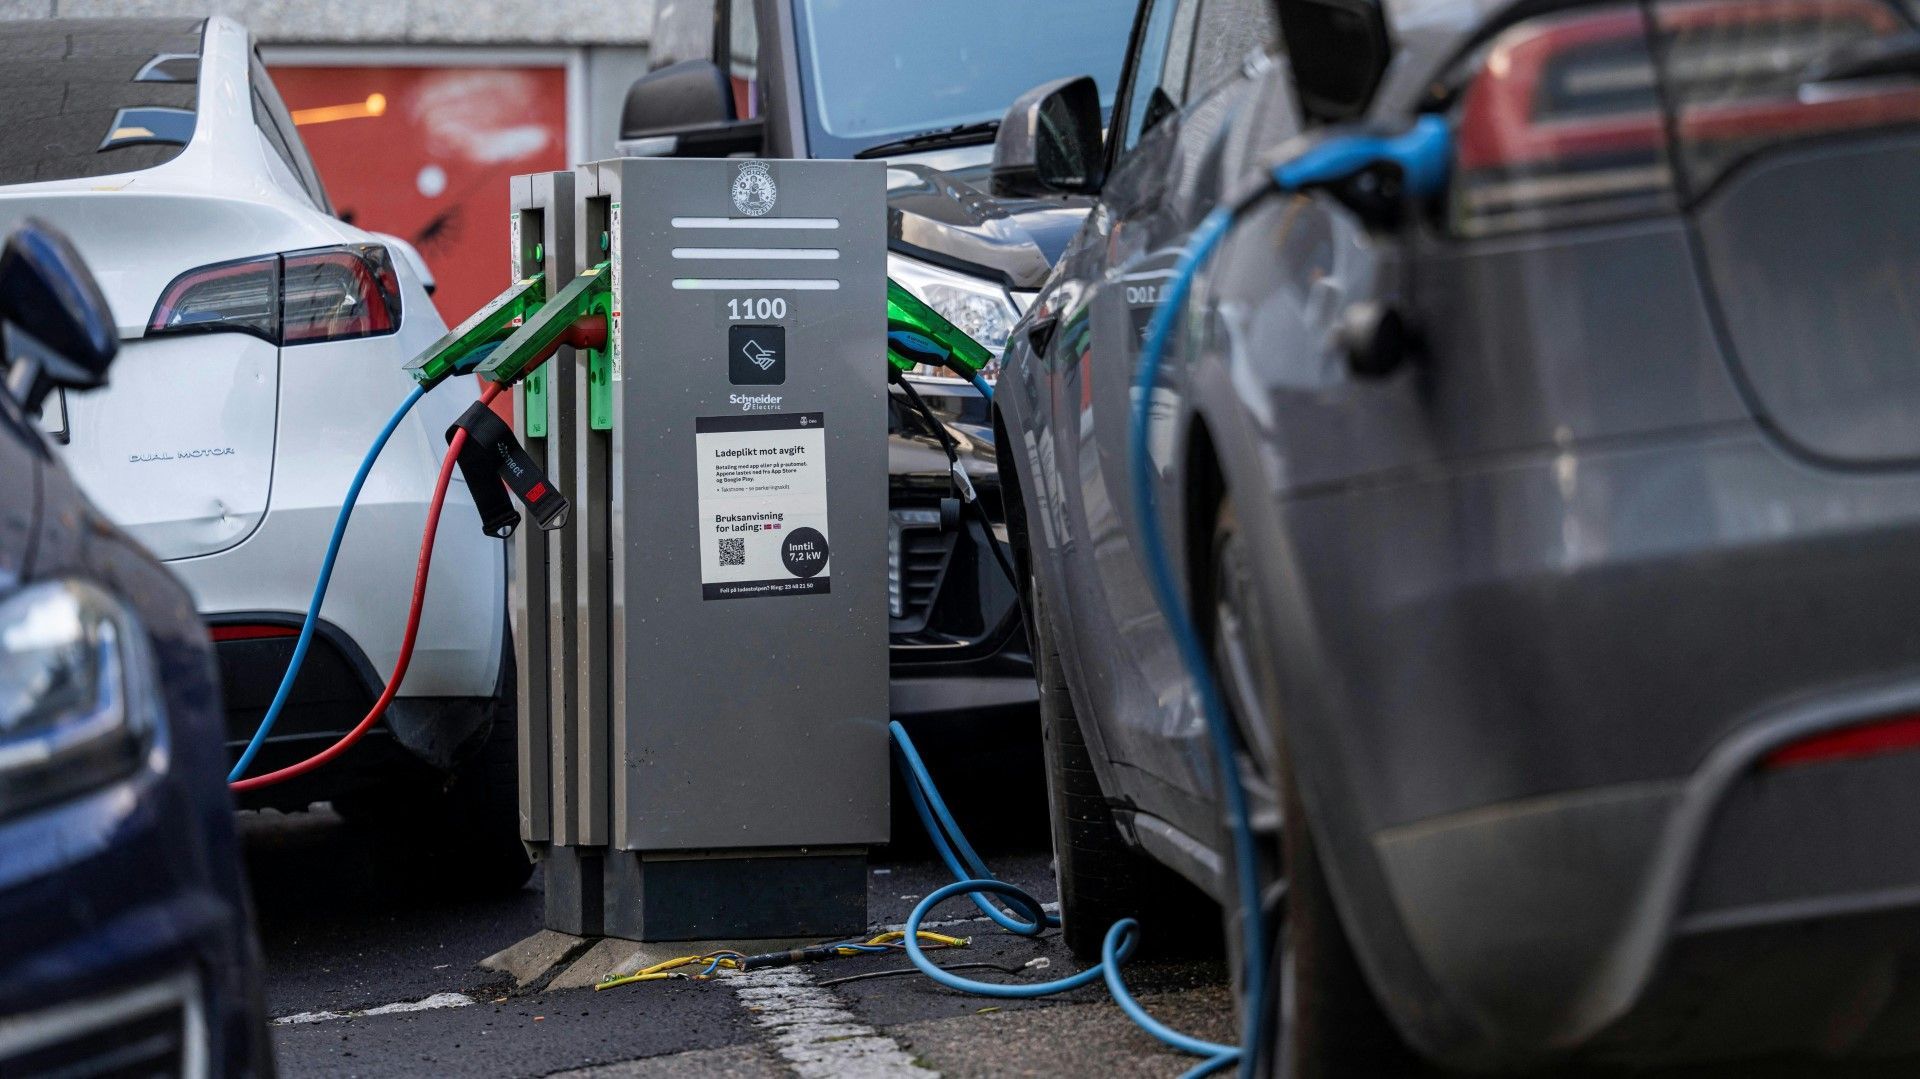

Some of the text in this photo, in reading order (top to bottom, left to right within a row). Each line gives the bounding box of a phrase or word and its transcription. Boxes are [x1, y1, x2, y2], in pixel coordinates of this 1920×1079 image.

[727, 297, 787, 320] 1100
[729, 394, 782, 404] Schneider
[129, 447, 235, 463] DUAL MOTOR
[715, 445, 805, 458] Ladeplikt mot avgift
[715, 511, 784, 523] Bruksanvisning
[731, 523, 762, 533] lading:
[789, 541, 814, 552] Inntil
[789, 551, 821, 563] 7,2 kW
